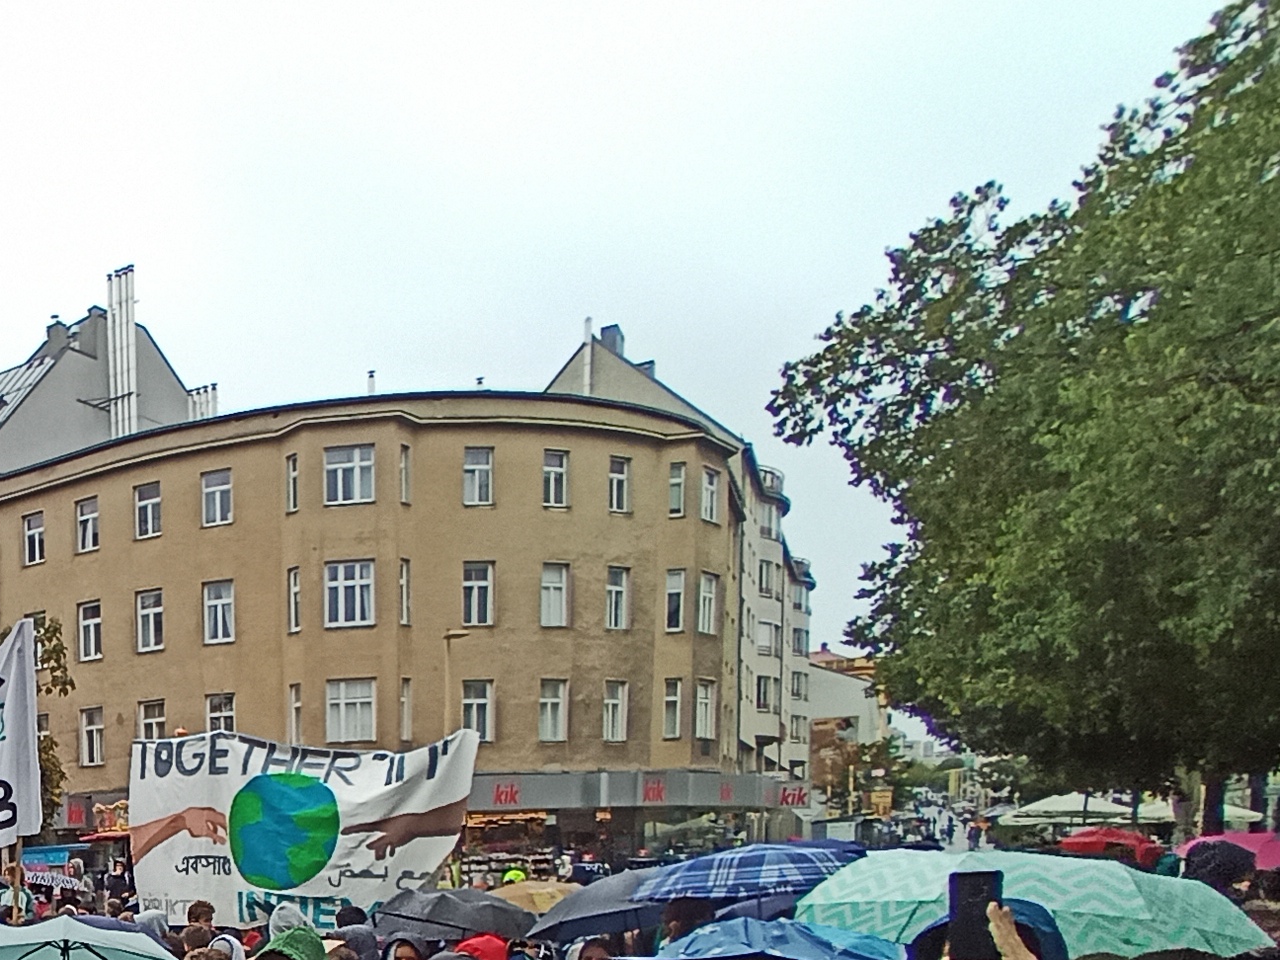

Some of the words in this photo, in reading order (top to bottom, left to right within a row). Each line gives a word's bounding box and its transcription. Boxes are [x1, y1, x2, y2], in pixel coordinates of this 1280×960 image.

[132, 732, 362, 787] TOGETHER
[494, 784, 519, 805] kik
[642, 779, 666, 803] kik
[780, 786, 808, 806] kik
